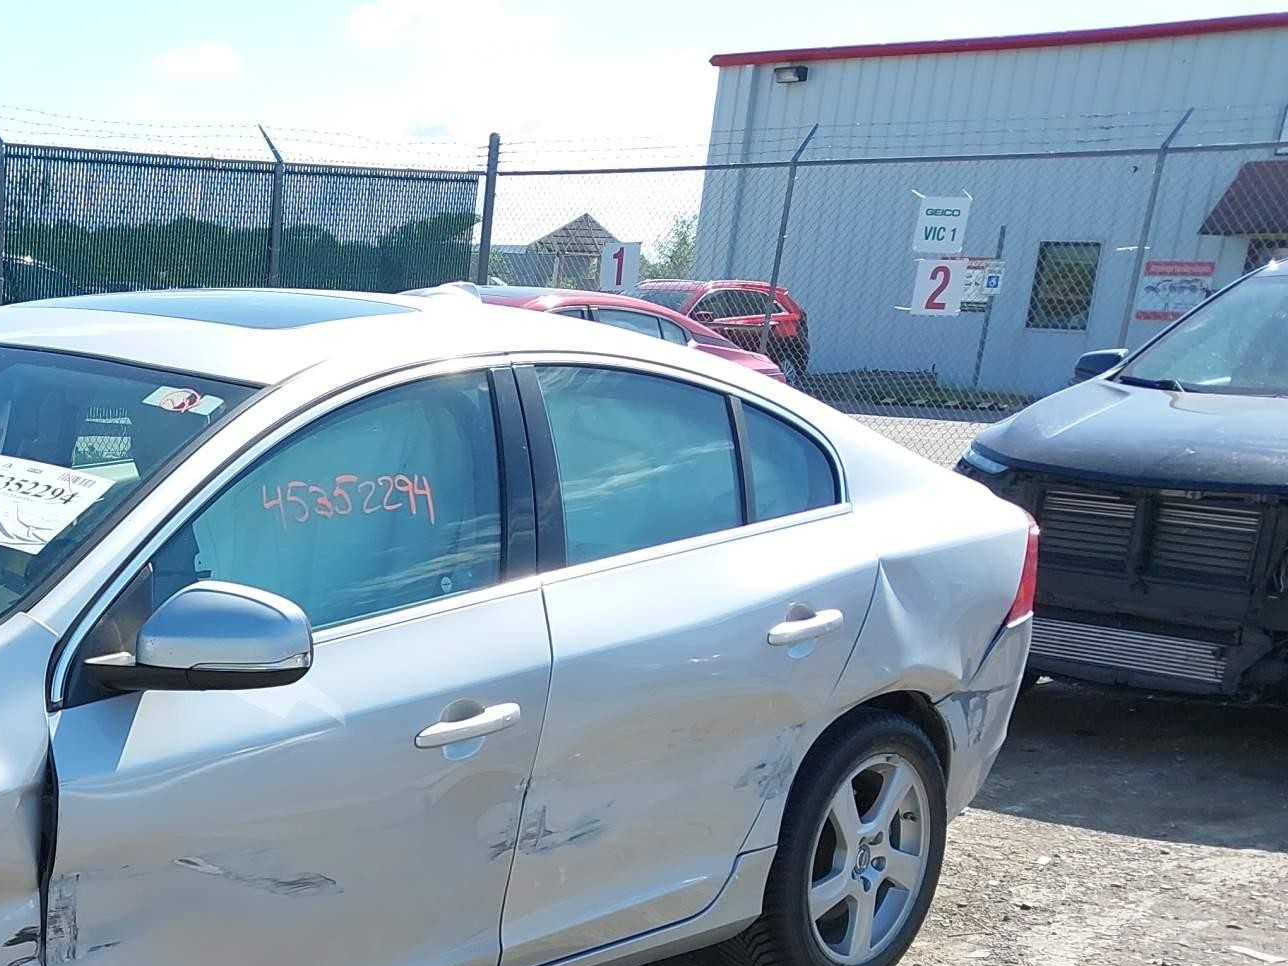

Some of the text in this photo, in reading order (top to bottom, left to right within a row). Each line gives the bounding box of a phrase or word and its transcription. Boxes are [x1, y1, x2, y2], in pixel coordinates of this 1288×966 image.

[925, 208, 961, 217] GEICO
[924, 225, 958, 242] VIC 1
[612, 246, 625, 286] 1
[924, 265, 952, 310] 2
[261, 474, 436, 529] 45352294
